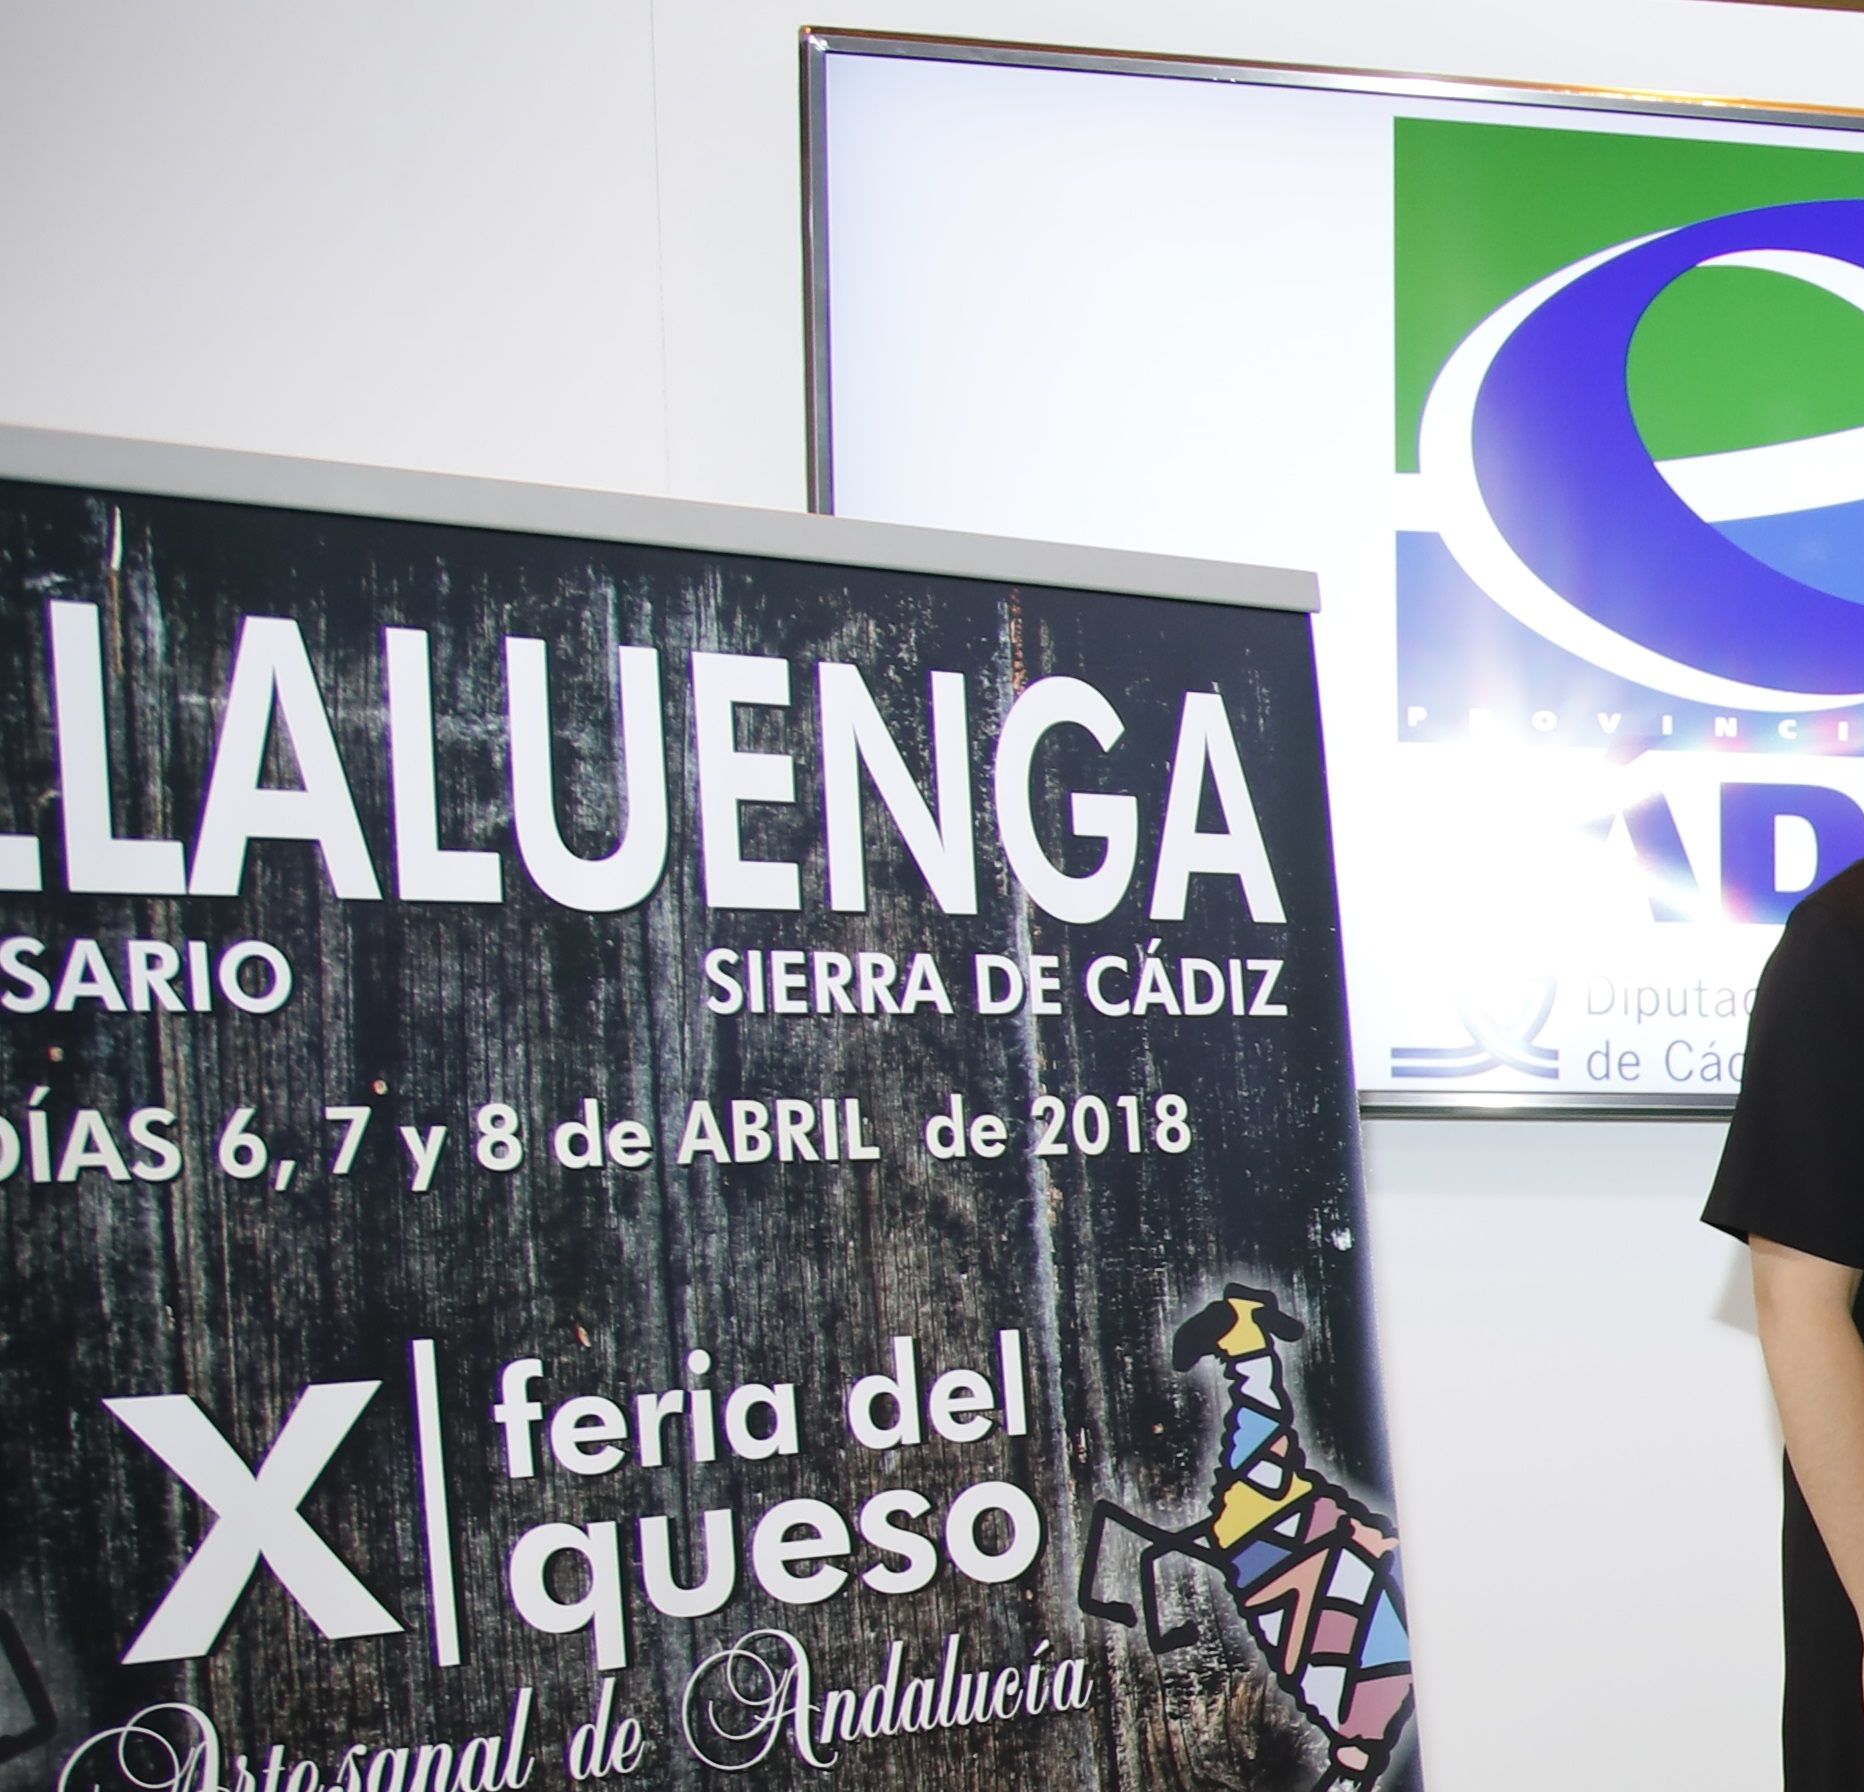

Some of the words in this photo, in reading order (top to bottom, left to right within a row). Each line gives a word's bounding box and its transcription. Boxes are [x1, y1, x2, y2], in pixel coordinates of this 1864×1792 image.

[703, 947, 953, 1016] SIERRA
[975, 953, 1063, 1018] DE
[1085, 937, 1290, 1020] CÁDIZ
[1587, 1038, 1640, 1081] de
[0, 1085, 184, 1184] ÍAS
[217, 1106, 297, 1191] 6,
[325, 1104, 372, 1176] 7
[402, 1116, 448, 1191] y
[476, 1104, 524, 1173] 8
[554, 1098, 654, 1171] de
[677, 1099, 882, 1165] ABRIL
[925, 1093, 1008, 1159] de
[1032, 1093, 1193, 1158] 2018
[100, 1379, 406, 1667] X
[493, 1350, 801, 1480] feria
[848, 1328, 1027, 1453] del
[506, 1479, 1045, 1673] queso
[567, 1679, 645, 1783] de
[679, 1626, 1095, 1774] Andalucía
